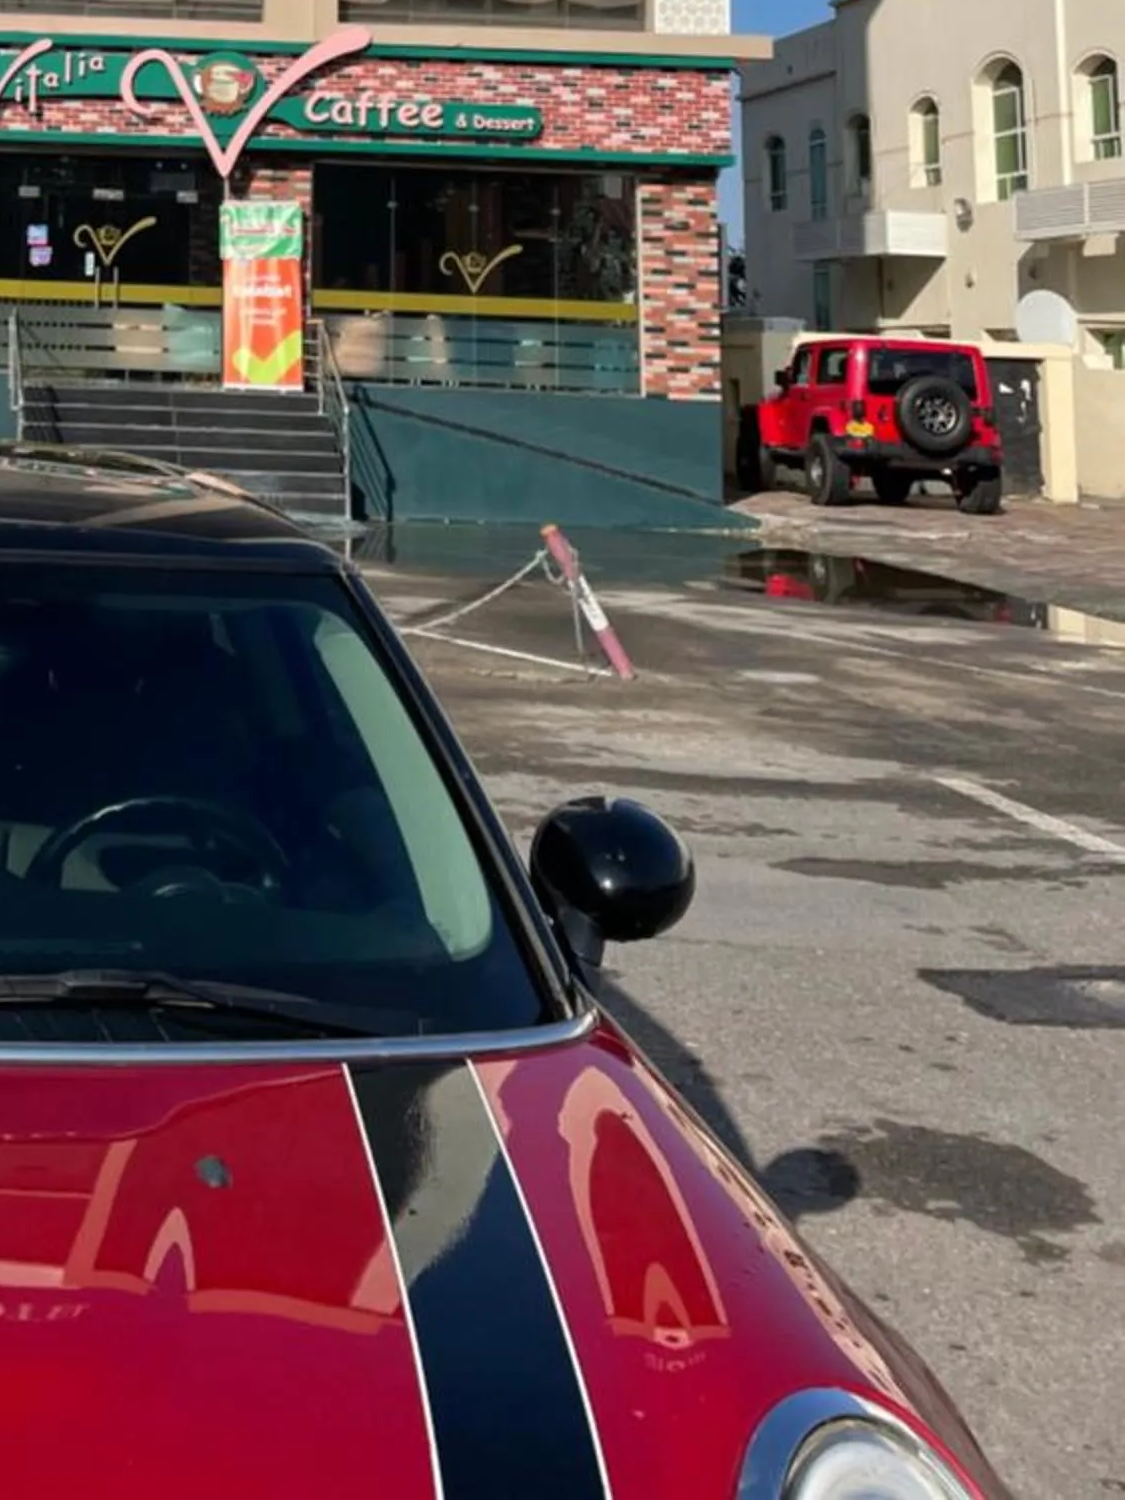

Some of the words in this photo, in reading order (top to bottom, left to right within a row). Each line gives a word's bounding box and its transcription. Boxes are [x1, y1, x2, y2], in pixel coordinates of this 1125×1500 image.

[304, 91, 445, 129] Caffee
[455, 112, 468, 130] &
[474, 112, 536, 132] Dessert
